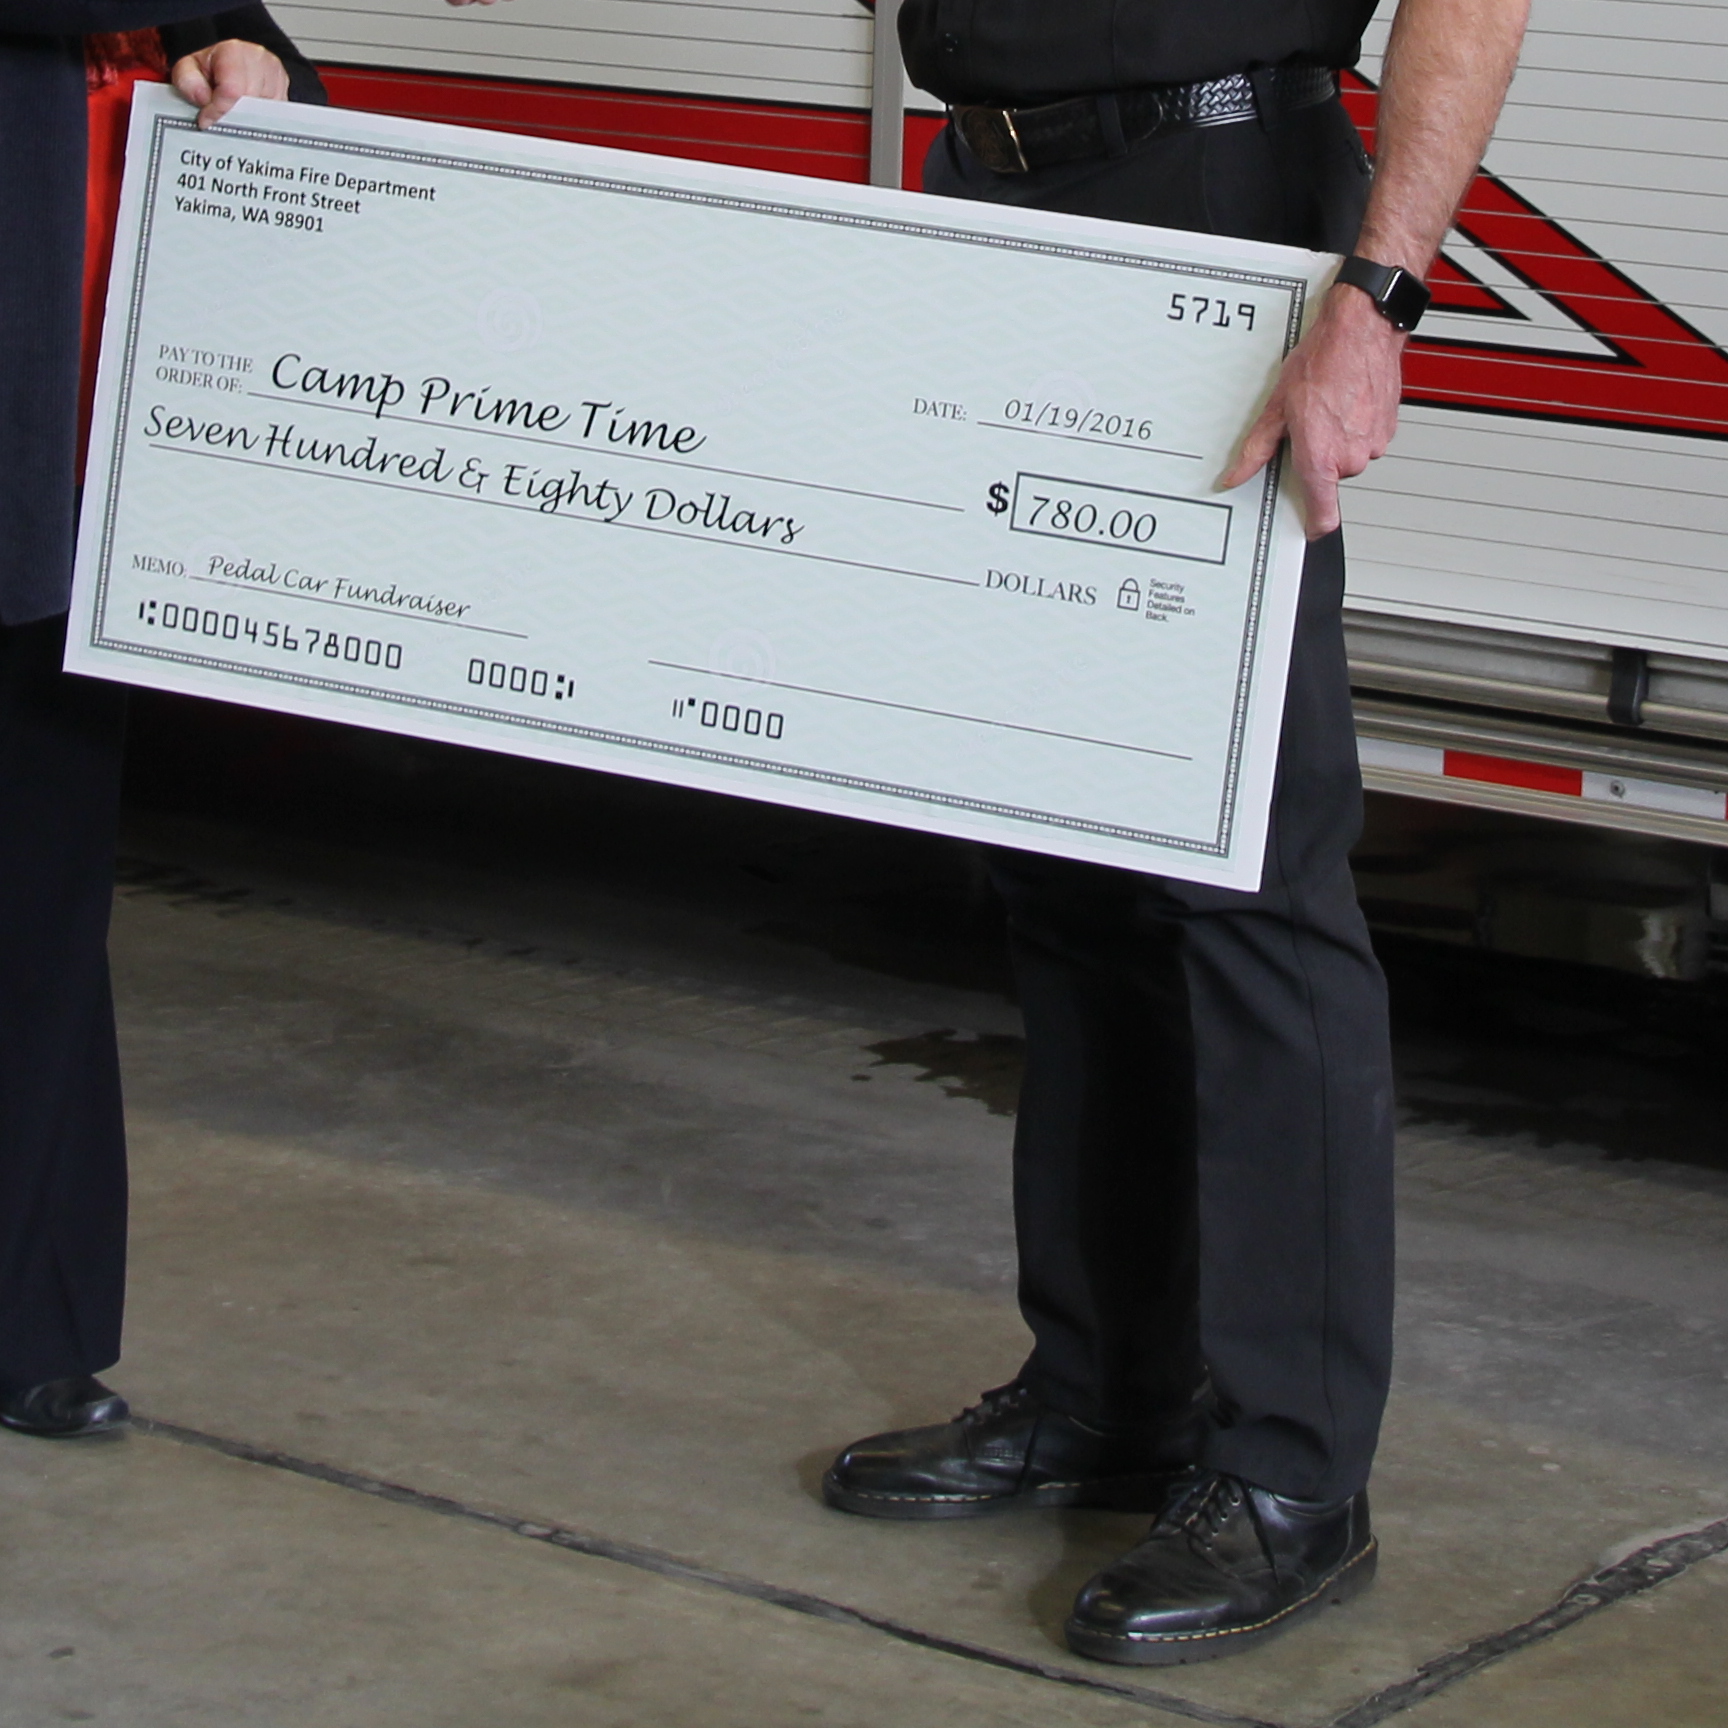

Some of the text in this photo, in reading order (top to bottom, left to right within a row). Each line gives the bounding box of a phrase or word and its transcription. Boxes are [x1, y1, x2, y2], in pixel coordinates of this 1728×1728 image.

[176, 173, 361, 215] 401 North Front Street
[180, 149, 437, 203] City of Yakima Fire Department
[174, 195, 324, 233] Yakima, WA 98901
[1165, 292, 1257, 332] 5719
[158, 343, 254, 374] PAY TO THE
[155, 365, 243, 395] ORDER OF:
[271, 352, 708, 454] Camp Prime Time
[912, 397, 1154, 442] DATE: 01/19/2016
[143, 404, 806, 546] Seven Hundred & Eighty Dollars
[986, 481, 1157, 543] $ 780.00
[208, 555, 283, 586] Pedal
[283, 569, 329, 595] Car
[333, 577, 472, 620] Fundraiser
[985, 568, 1098, 606] DOLLARS
[1147, 588, 1185, 603] Features
[1149, 577, 1185, 594] Security
[1146, 599, 1195, 616] Detailed on
